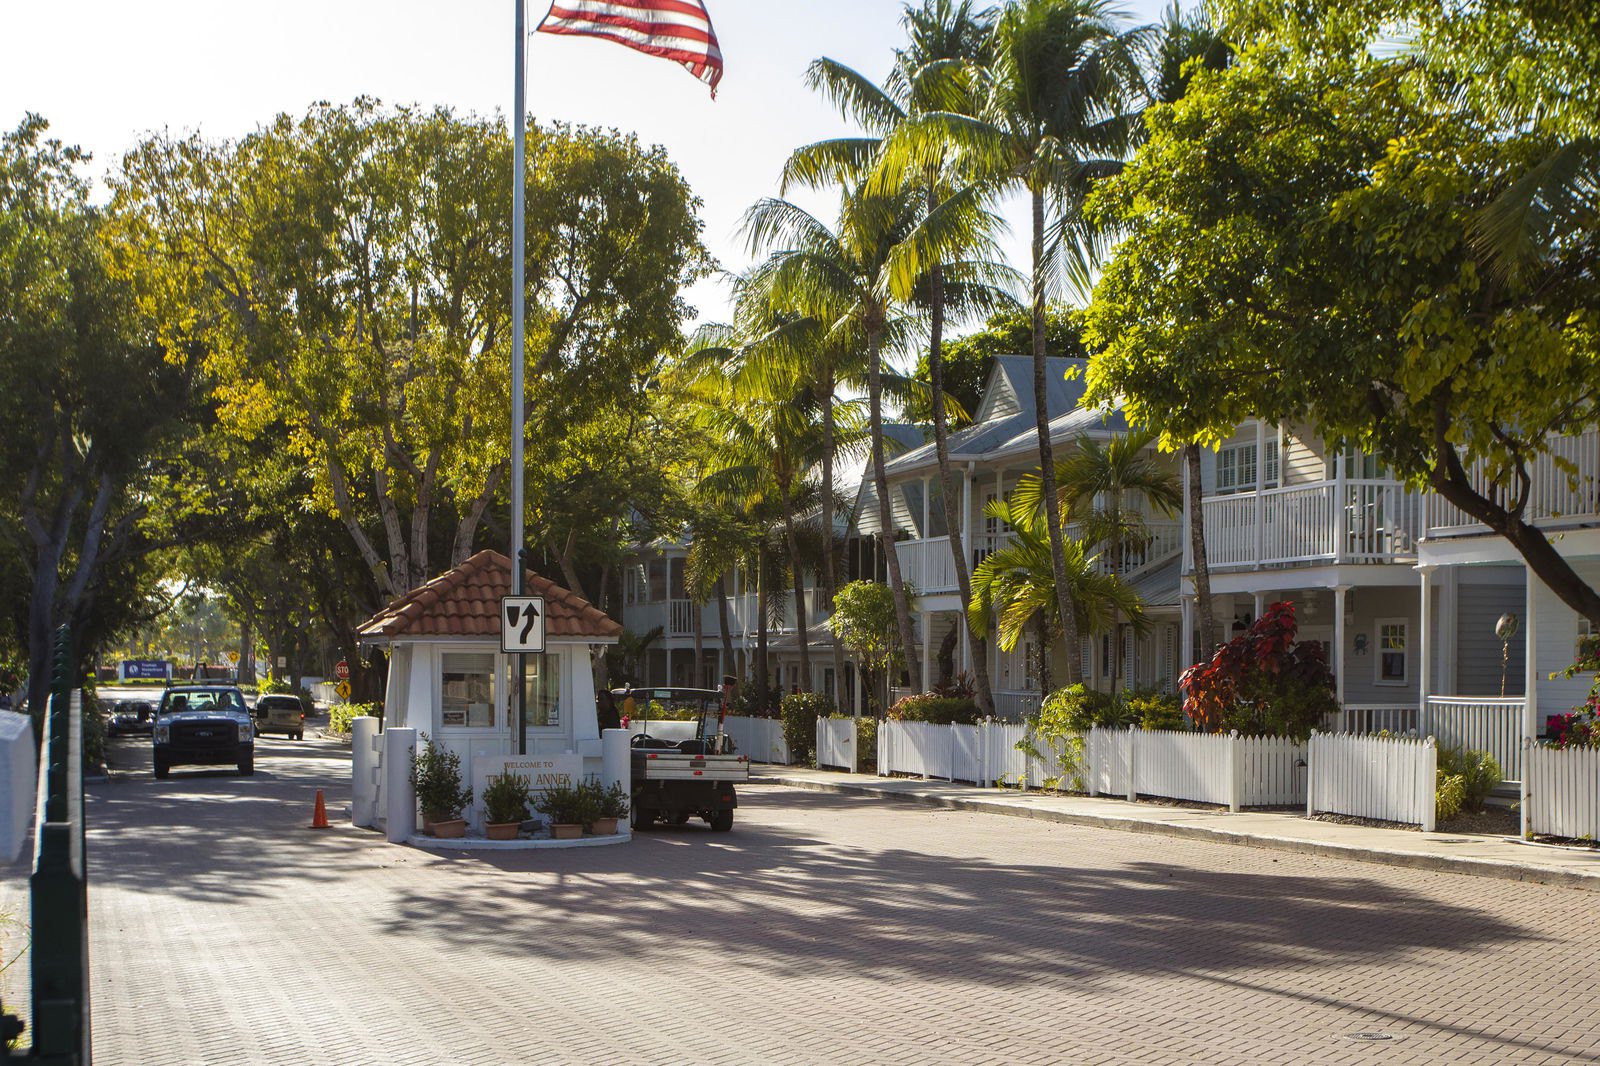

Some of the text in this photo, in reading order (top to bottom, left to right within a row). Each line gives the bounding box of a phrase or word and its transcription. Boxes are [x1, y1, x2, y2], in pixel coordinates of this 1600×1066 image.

[337, 666, 349, 674] STO
[504, 761, 554, 769] WELCOME TO
[536, 773, 571, 785] ANNEX
